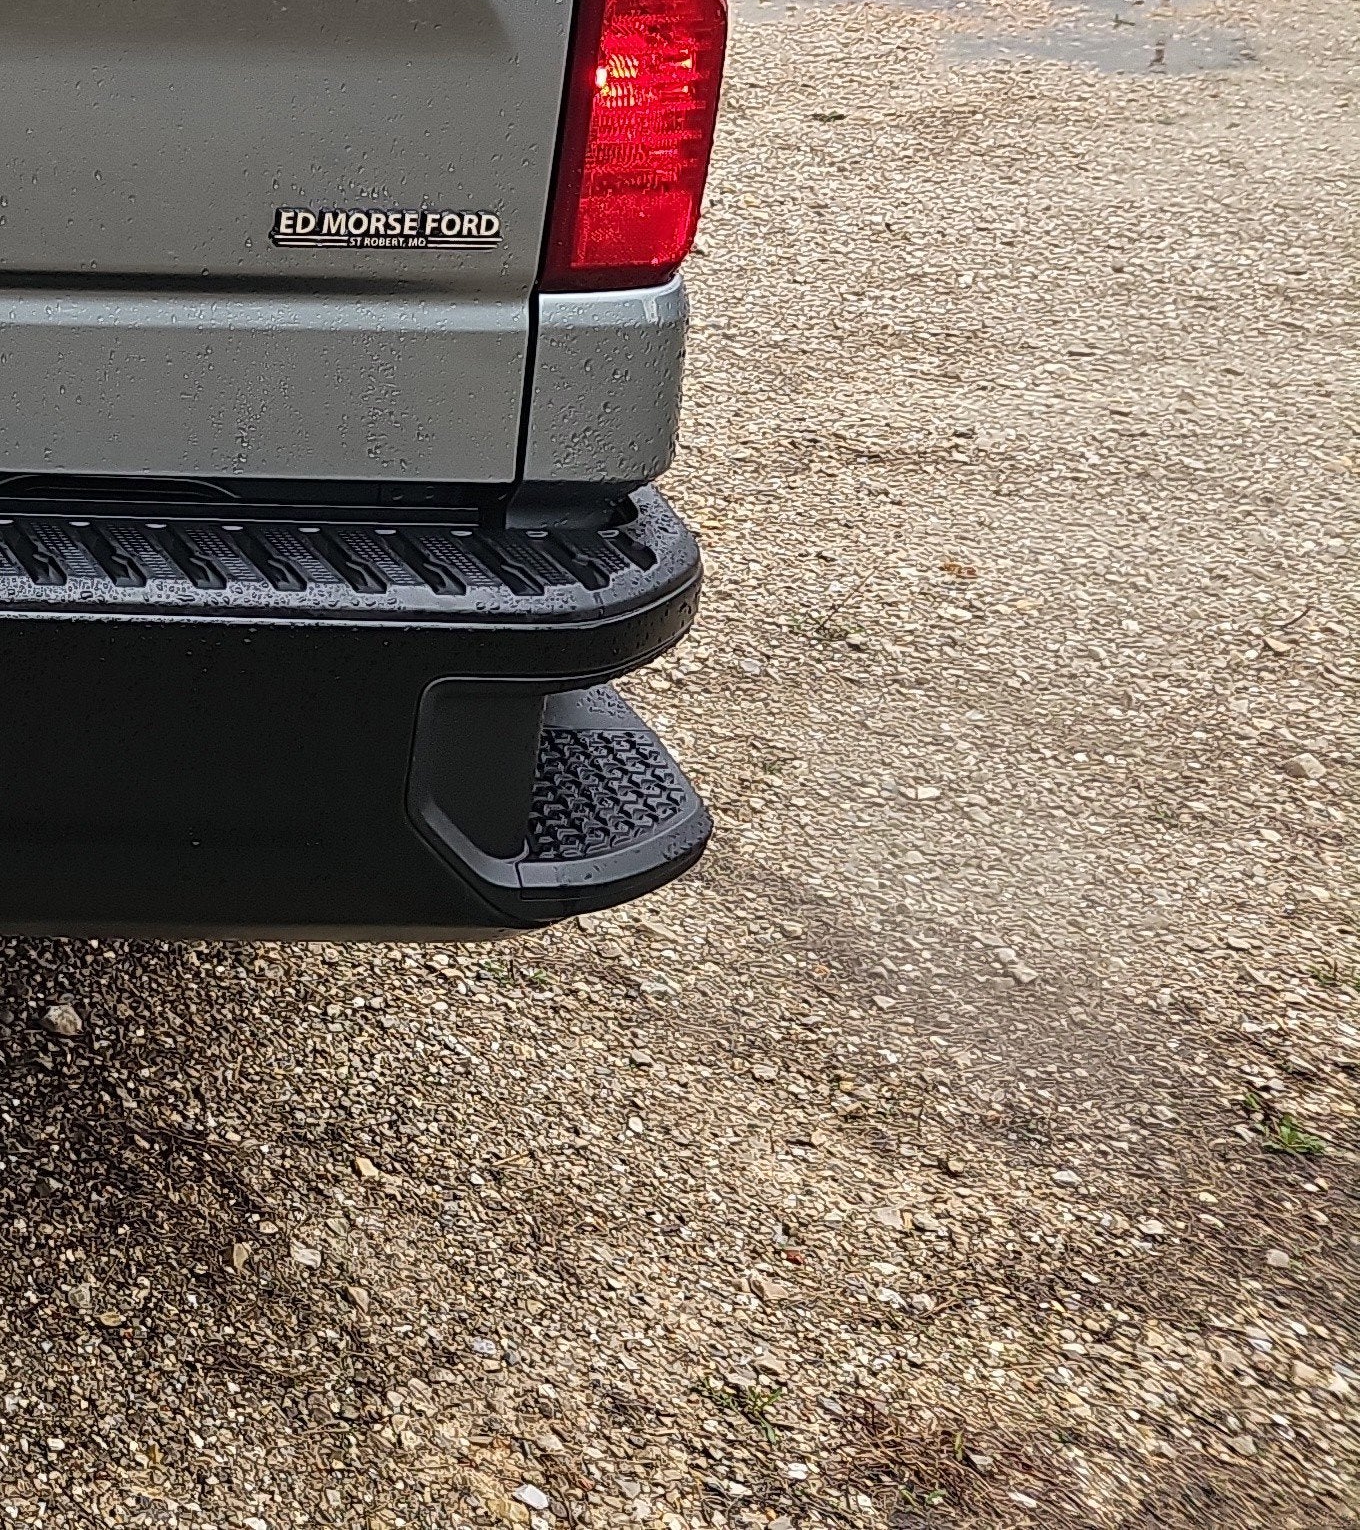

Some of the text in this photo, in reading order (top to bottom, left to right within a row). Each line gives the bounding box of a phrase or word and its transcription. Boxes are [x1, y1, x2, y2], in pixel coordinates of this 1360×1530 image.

[279, 210, 501, 236] ED MORSE FORD
[349, 237, 362, 247] ST
[408, 238, 426, 248] MO
